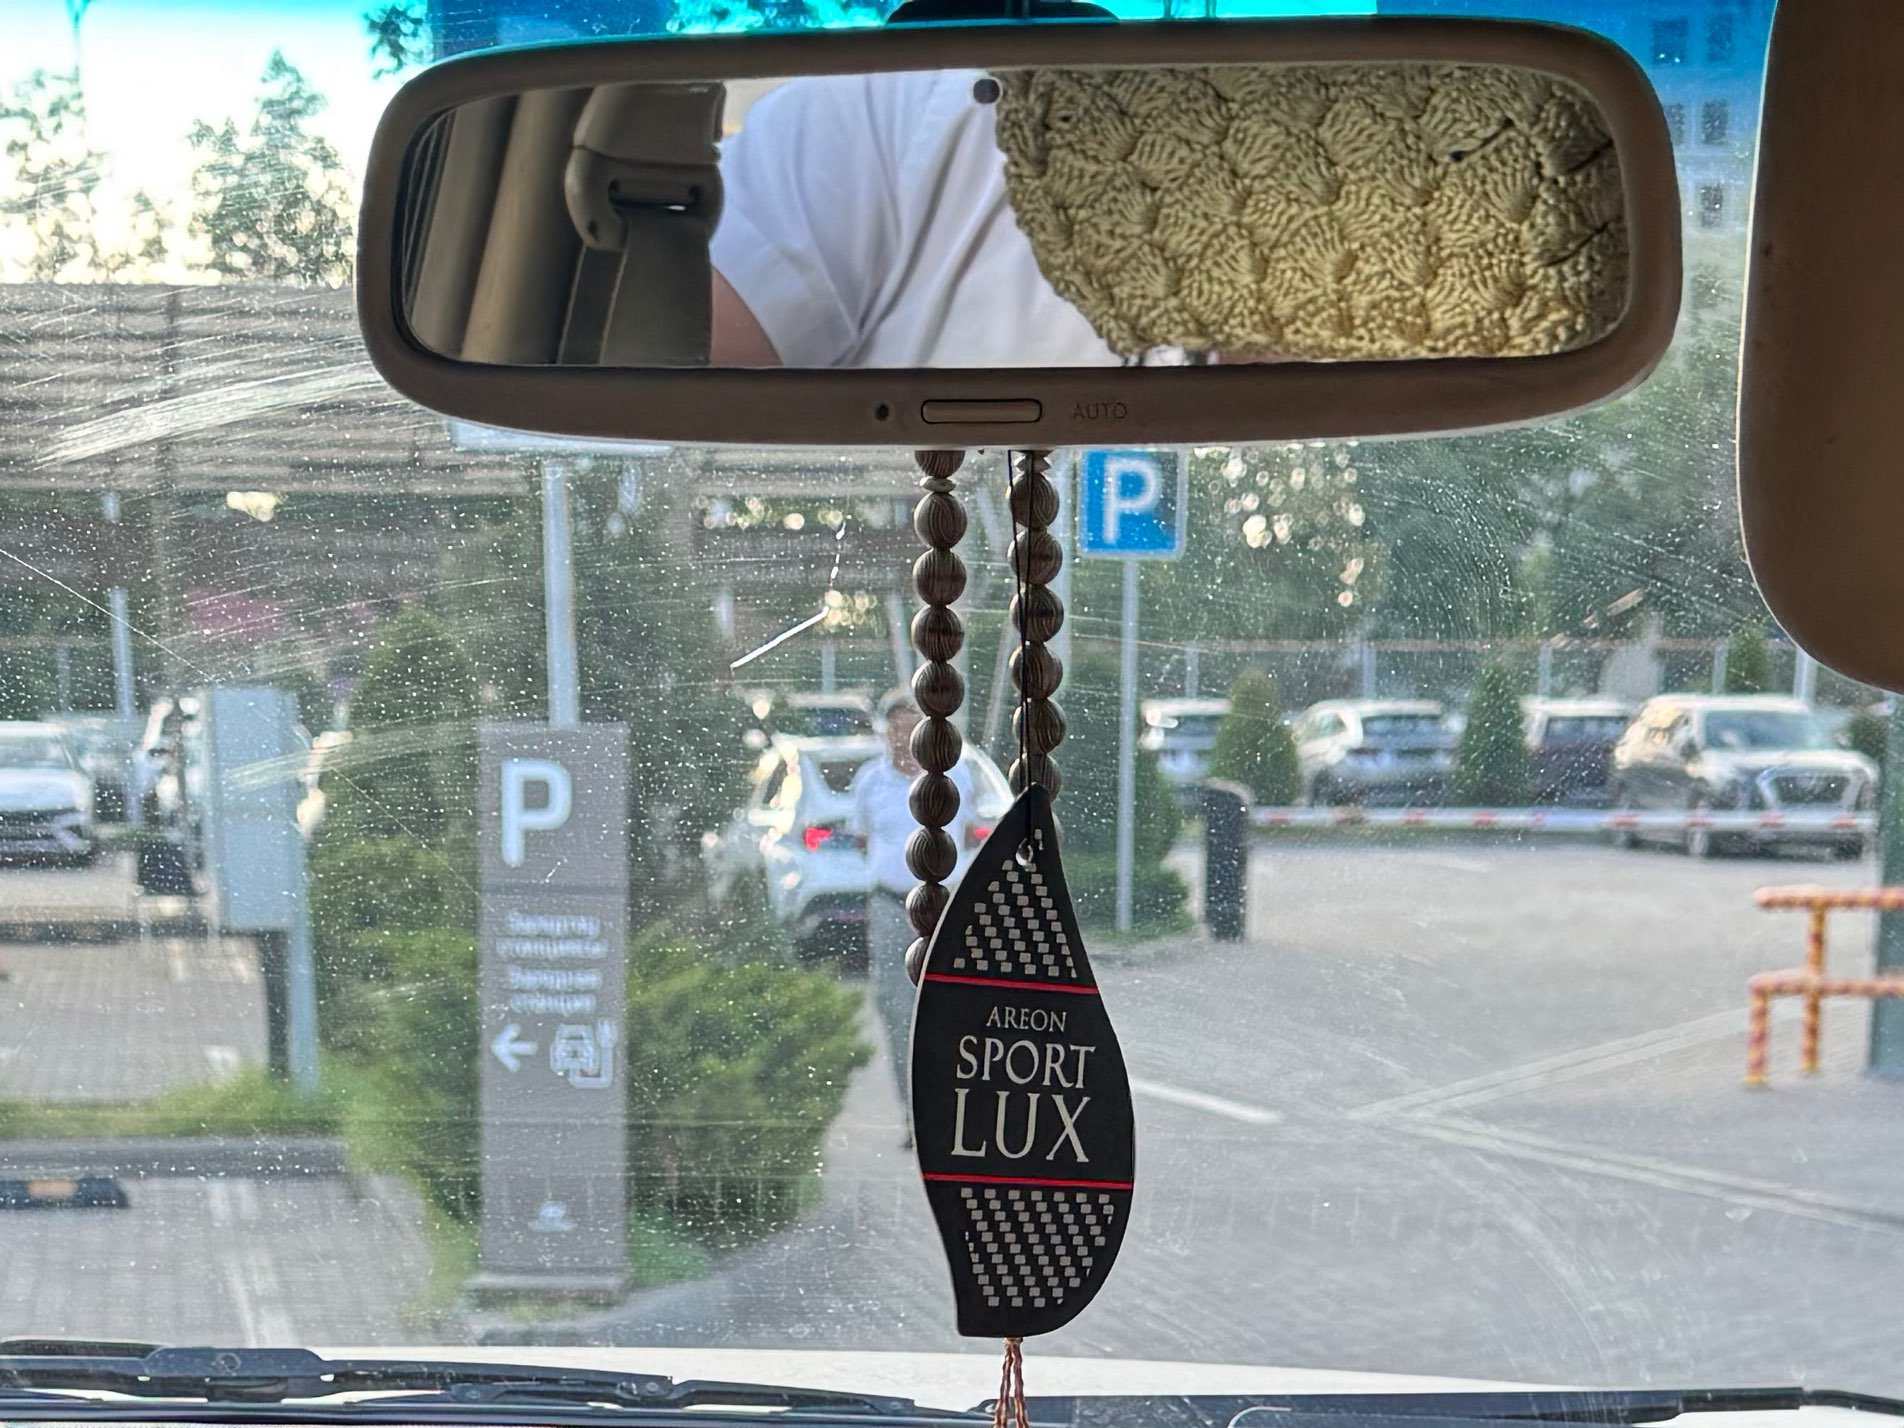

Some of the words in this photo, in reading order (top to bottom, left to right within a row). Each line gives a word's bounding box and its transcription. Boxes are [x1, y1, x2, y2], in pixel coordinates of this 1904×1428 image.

[1072, 401, 1129, 420] AUTO
[1102, 458, 1162, 545] P
[501, 758, 572, 867] P
[985, 1005, 1068, 1033] AREON
[956, 1034, 1096, 1089] SPORT
[950, 1088, 1092, 1163] LUX
